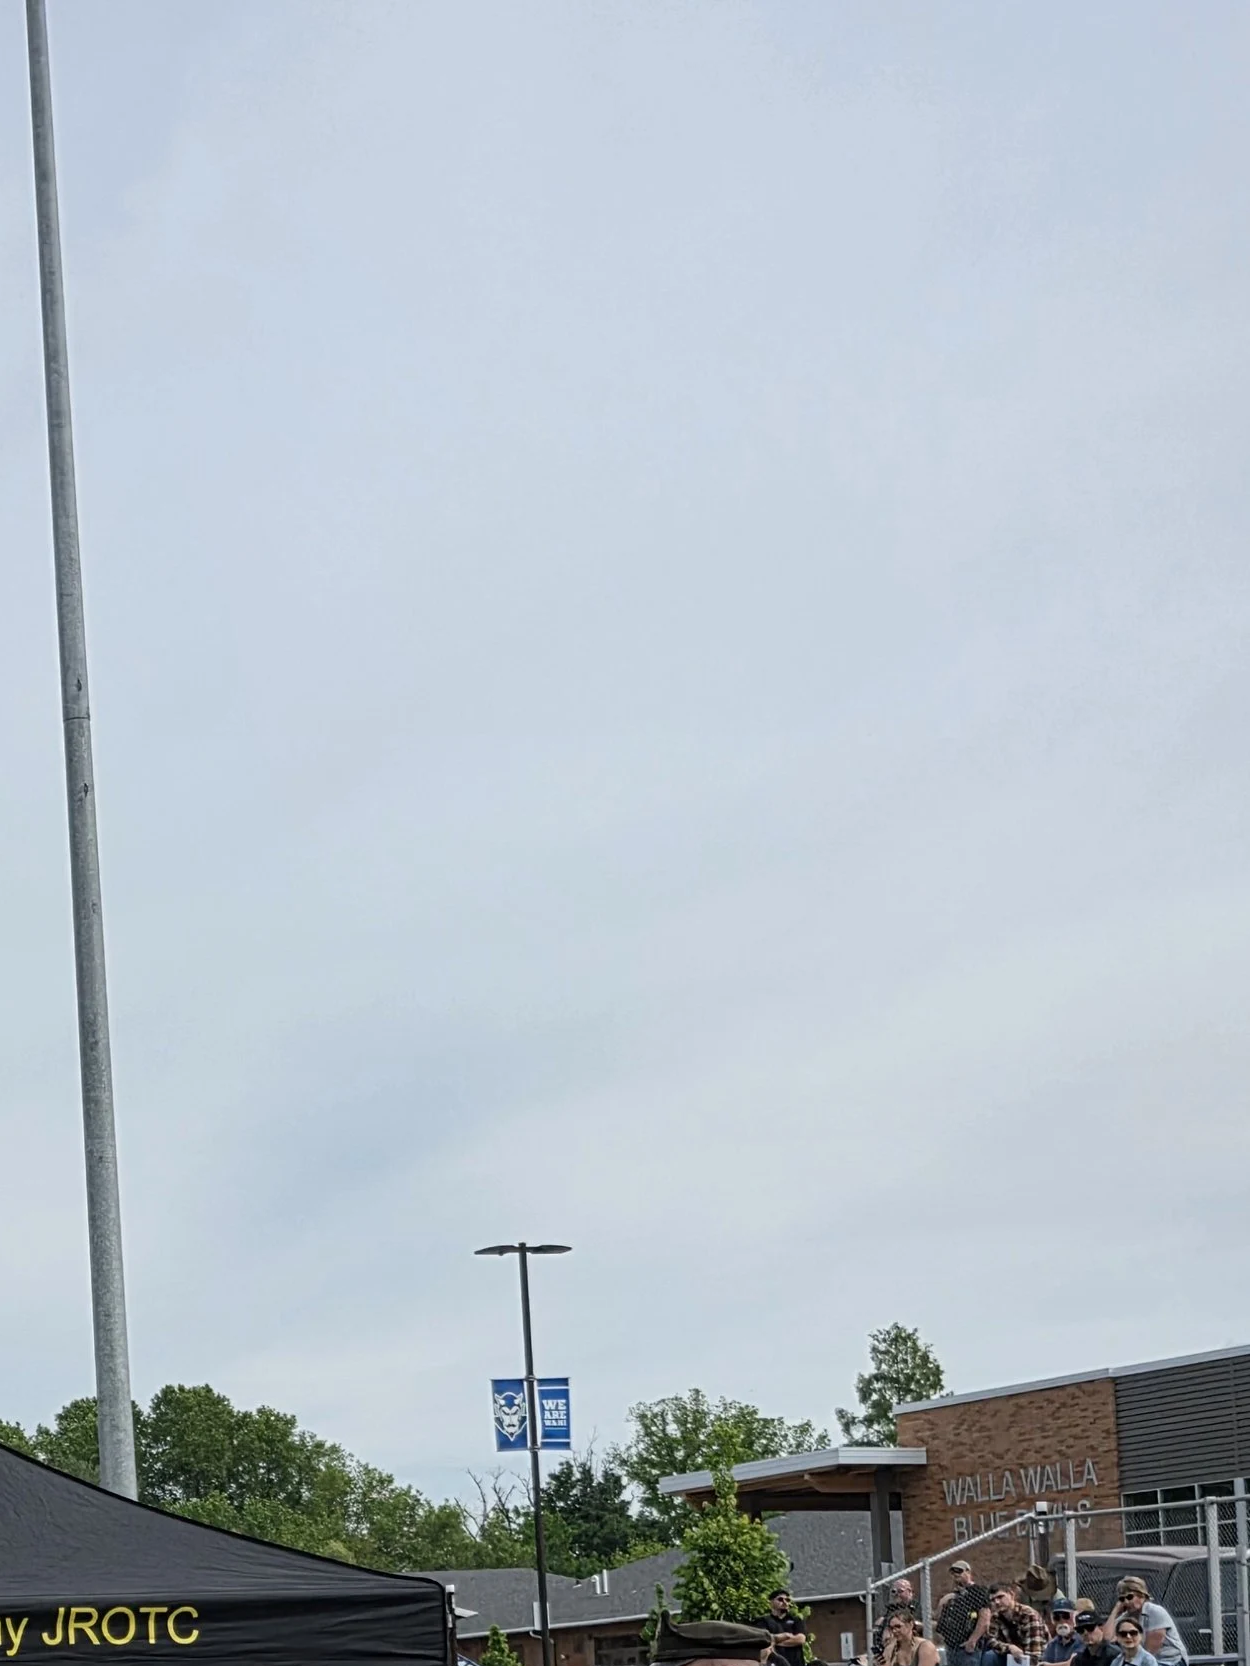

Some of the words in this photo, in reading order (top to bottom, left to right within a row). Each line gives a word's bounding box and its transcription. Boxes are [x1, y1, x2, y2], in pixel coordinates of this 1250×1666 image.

[542, 1399, 567, 1410] WE
[544, 1410, 567, 1420] ARE
[943, 1470, 1016, 1506] WALLA
[1020, 1458, 1098, 1495] WALLA
[954, 1511, 1010, 1543] BLUE
[1016, 1499, 1092, 1536] DVIS
[41, 1606, 199, 1645] JROTC
